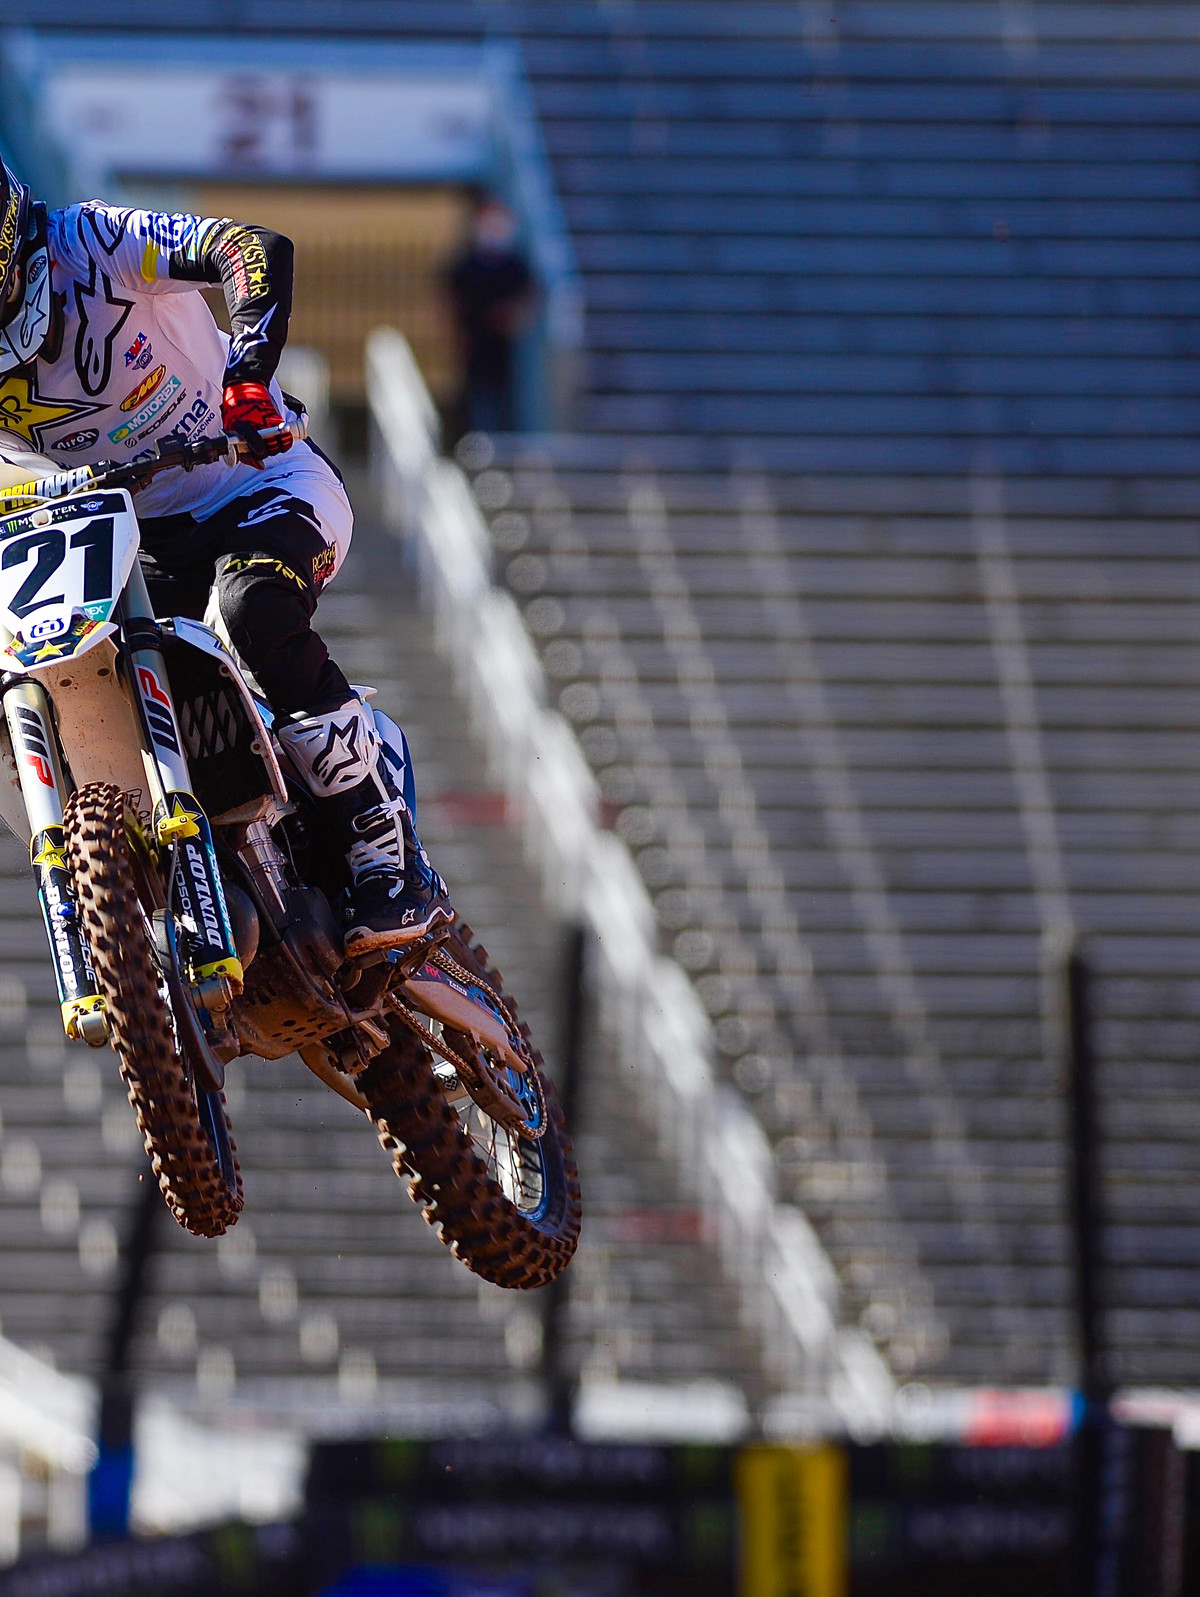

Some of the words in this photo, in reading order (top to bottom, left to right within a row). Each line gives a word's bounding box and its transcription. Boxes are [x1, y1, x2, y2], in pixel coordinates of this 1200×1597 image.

[122, 364, 166, 411] FMF
[128, 378, 179, 431] MOTOREX
[57, 431, 98, 450] Airoh
[193, 412, 216, 441] RACING
[1, 516, 115, 620] 21
[137, 667, 182, 758] WP
[16, 706, 55, 789] WP
[186, 844, 224, 950] DUNLOP
[46, 885, 78, 990] DUNLOP
[424, 963, 442, 979] RK
